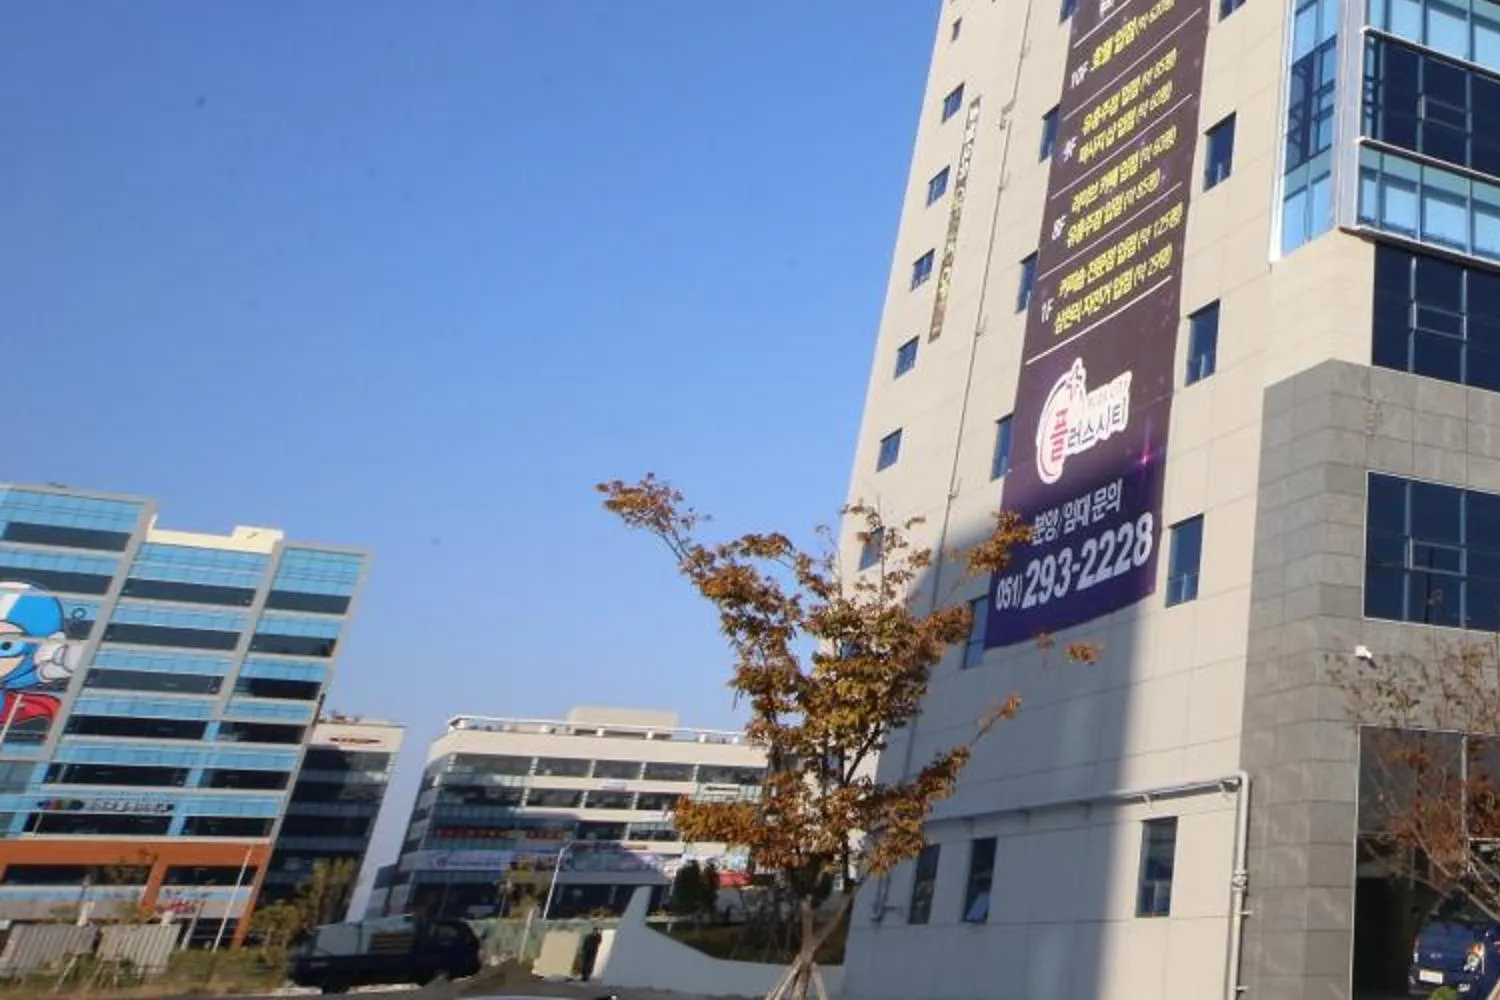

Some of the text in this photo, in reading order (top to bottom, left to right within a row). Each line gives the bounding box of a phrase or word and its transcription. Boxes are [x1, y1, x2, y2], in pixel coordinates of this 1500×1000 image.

[1050, 400, 1126, 462] 플러스시티
[1092, 479, 1122, 521] 문의
[1023, 514, 1153, 607] 293-2228
